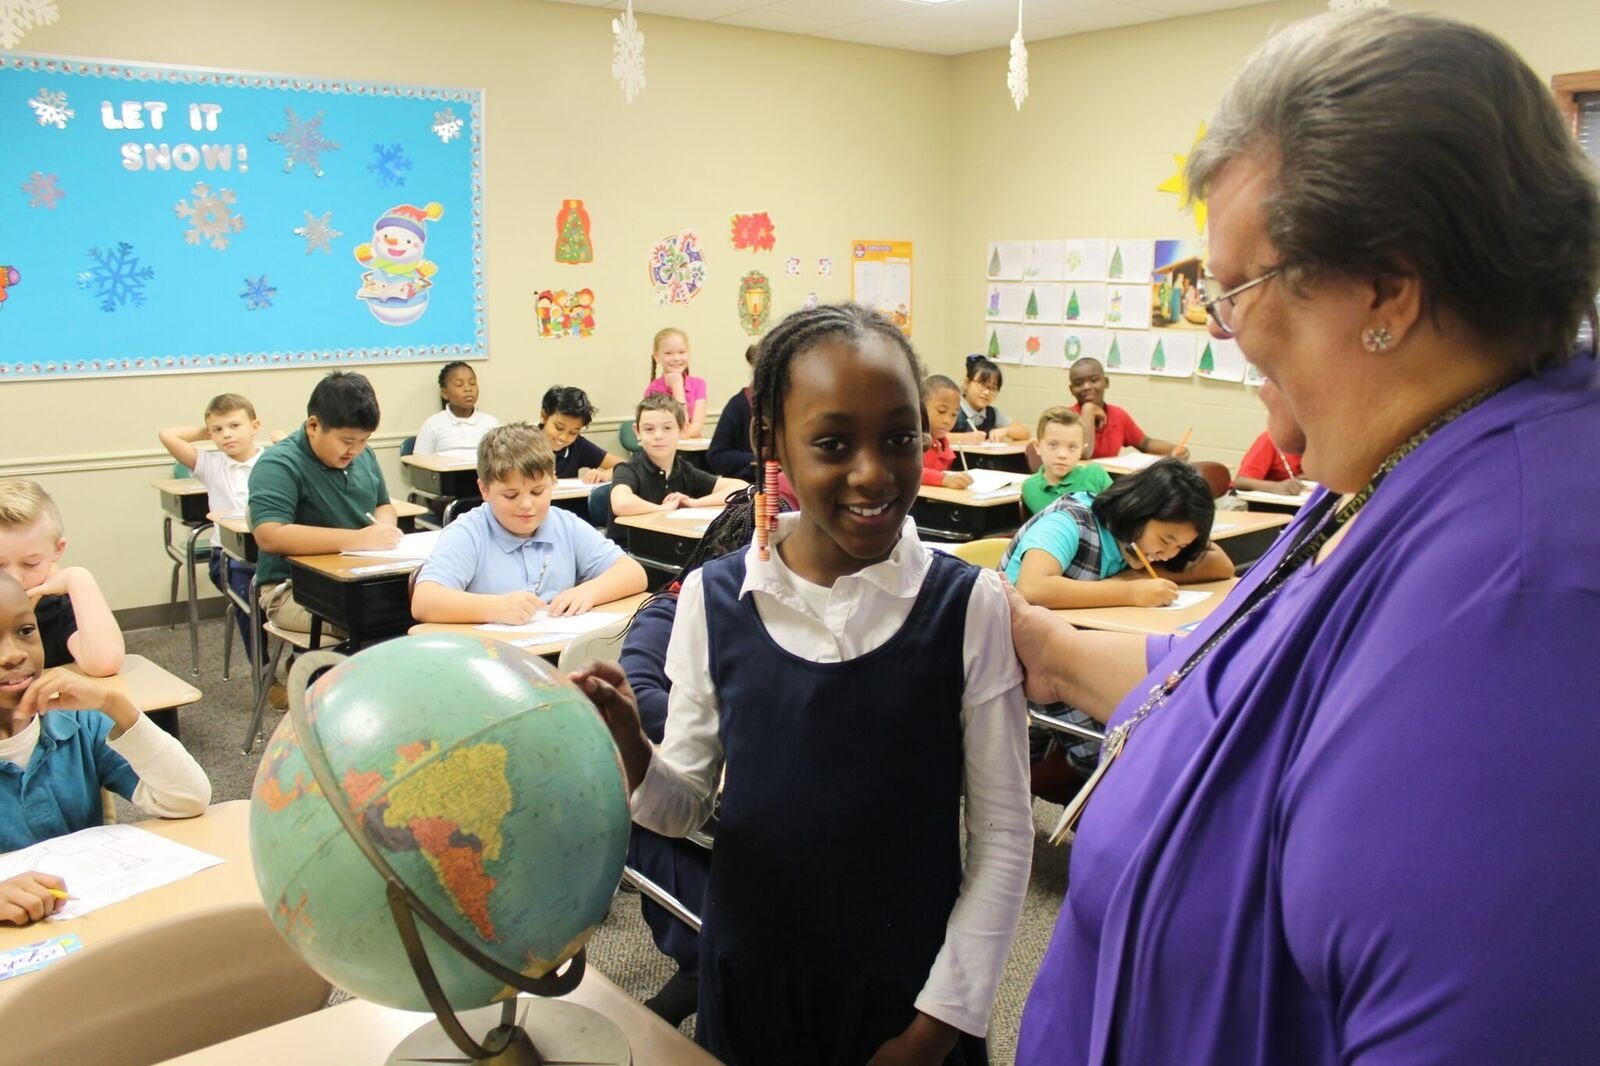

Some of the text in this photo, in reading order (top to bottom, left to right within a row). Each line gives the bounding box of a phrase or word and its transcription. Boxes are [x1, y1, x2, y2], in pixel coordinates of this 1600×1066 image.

[101, 100, 223, 132] LET IT
[121, 142, 249, 173] SNOW!
